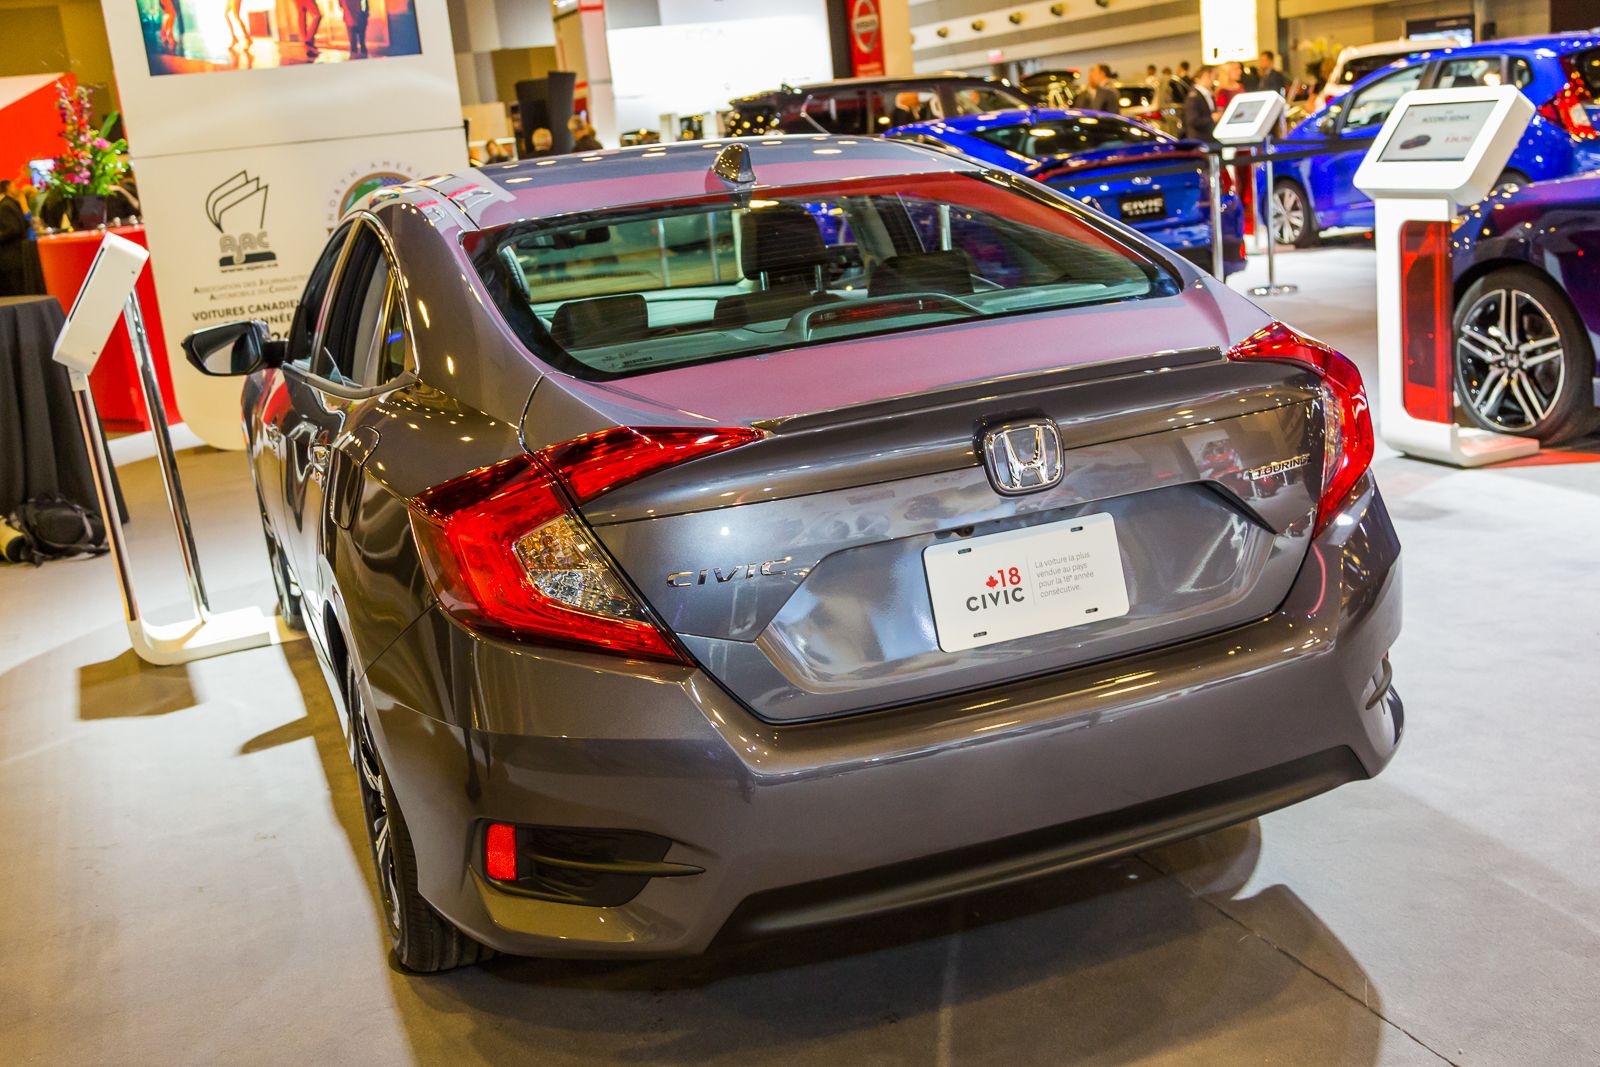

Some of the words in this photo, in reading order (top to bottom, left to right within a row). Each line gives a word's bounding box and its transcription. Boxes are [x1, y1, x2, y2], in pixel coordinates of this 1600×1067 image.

[1122, 197, 1163, 212] CIVIC
[192, 305, 246, 321] VOITURES
[1249, 453, 1312, 481] TOURING
[1034, 560, 1043, 569] La
[1043, 556, 1067, 567] voiture
[1068, 554, 1075, 562] la
[1075, 551, 1091, 562] plus
[666, 556, 793, 587] CIVIC
[997, 566, 1022, 588] 18
[1036, 567, 1061, 578] vendue
[1072, 562, 1088, 573] pays
[1038, 579, 1054, 589] pour
[1073, 571, 1095, 581] année
[966, 587, 1025, 612] CIVIC
